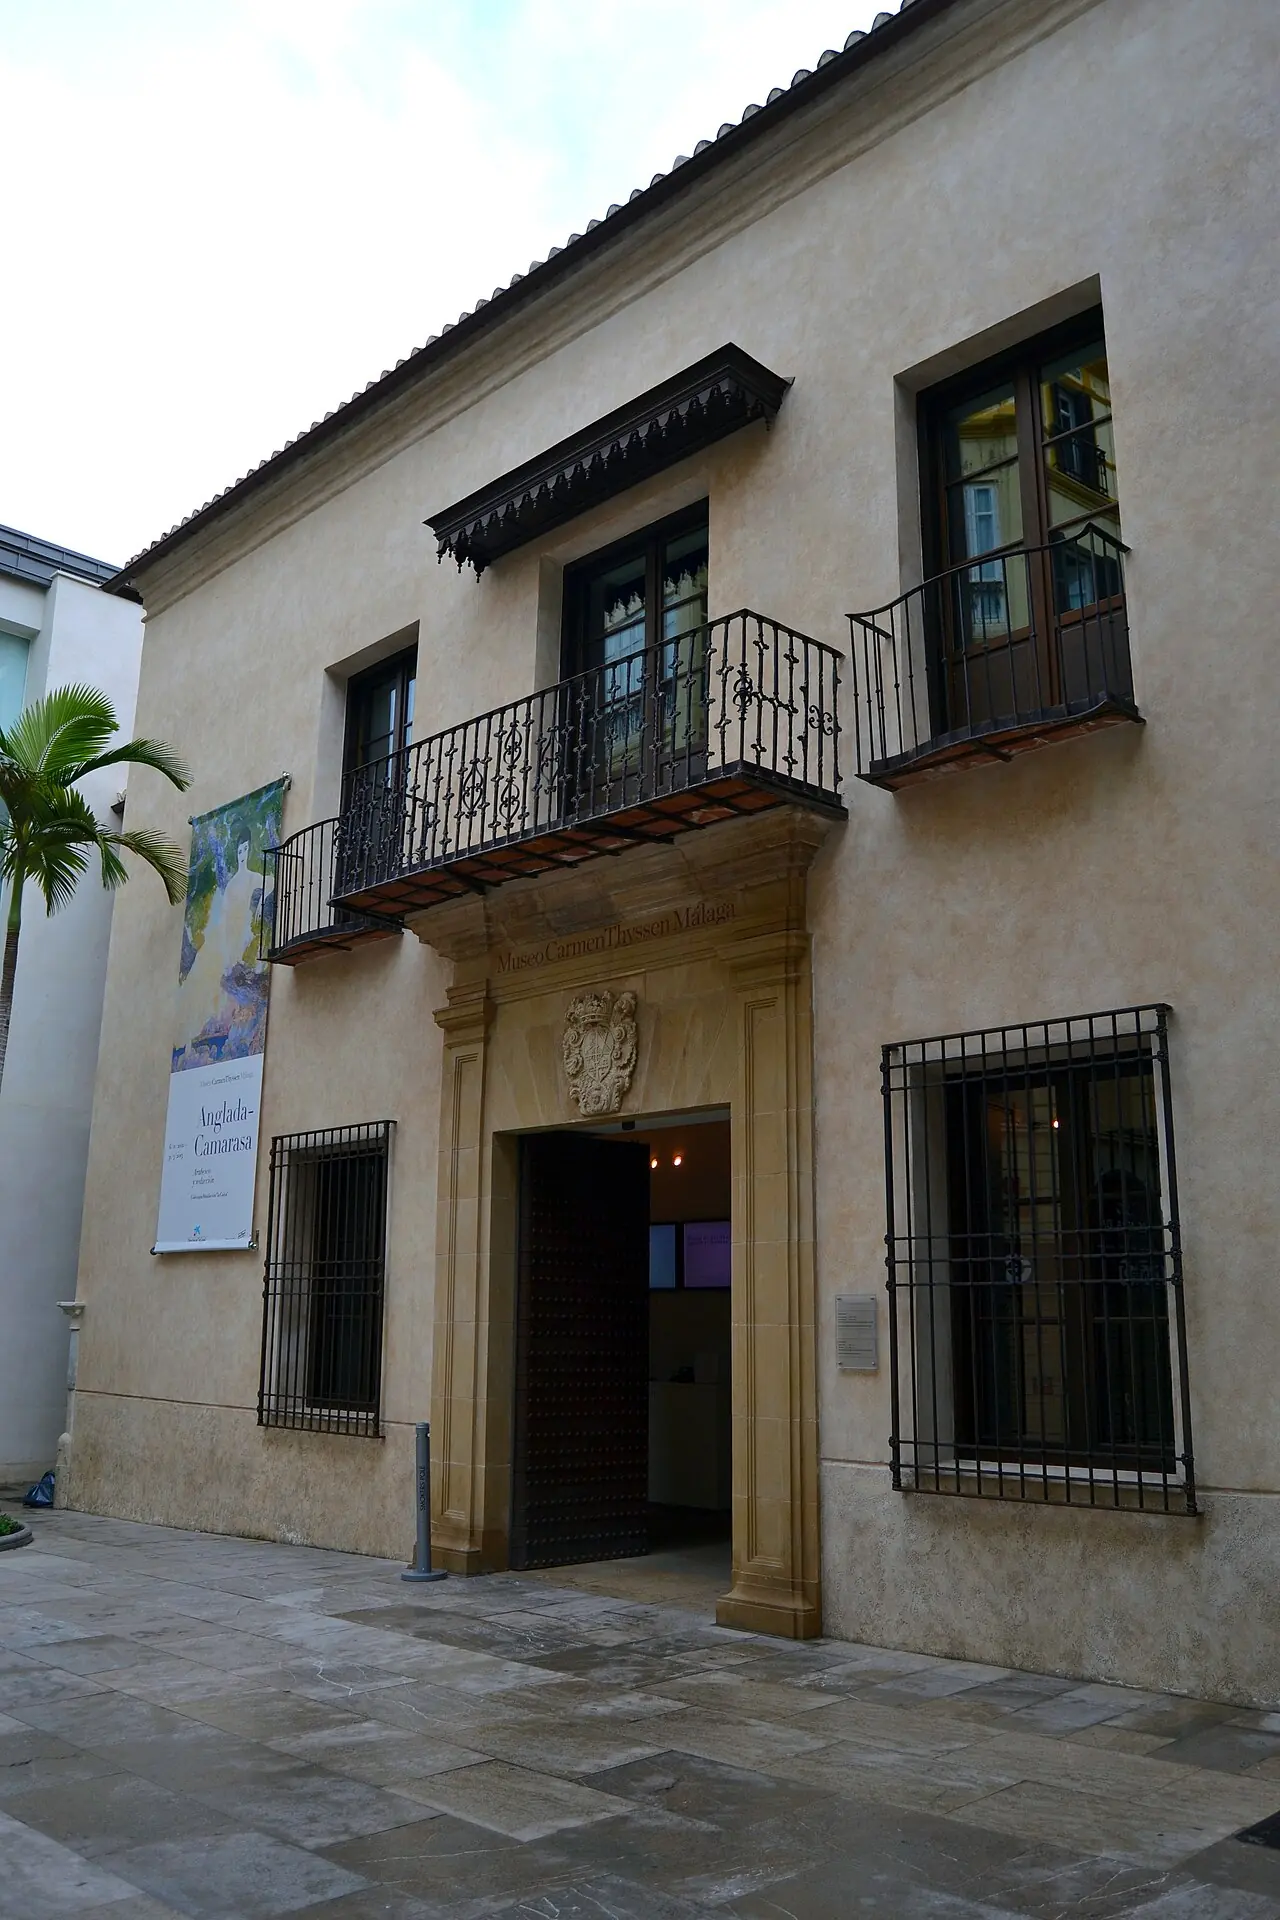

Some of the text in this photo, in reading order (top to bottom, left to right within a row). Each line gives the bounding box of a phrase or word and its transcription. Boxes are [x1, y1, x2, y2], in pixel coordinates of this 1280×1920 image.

[497, 901, 736, 973] Museo Carmen Thyssen Málaga
[199, 1098, 254, 1134] Anglada-
[194, 1135, 252, 1157] Camarasa
